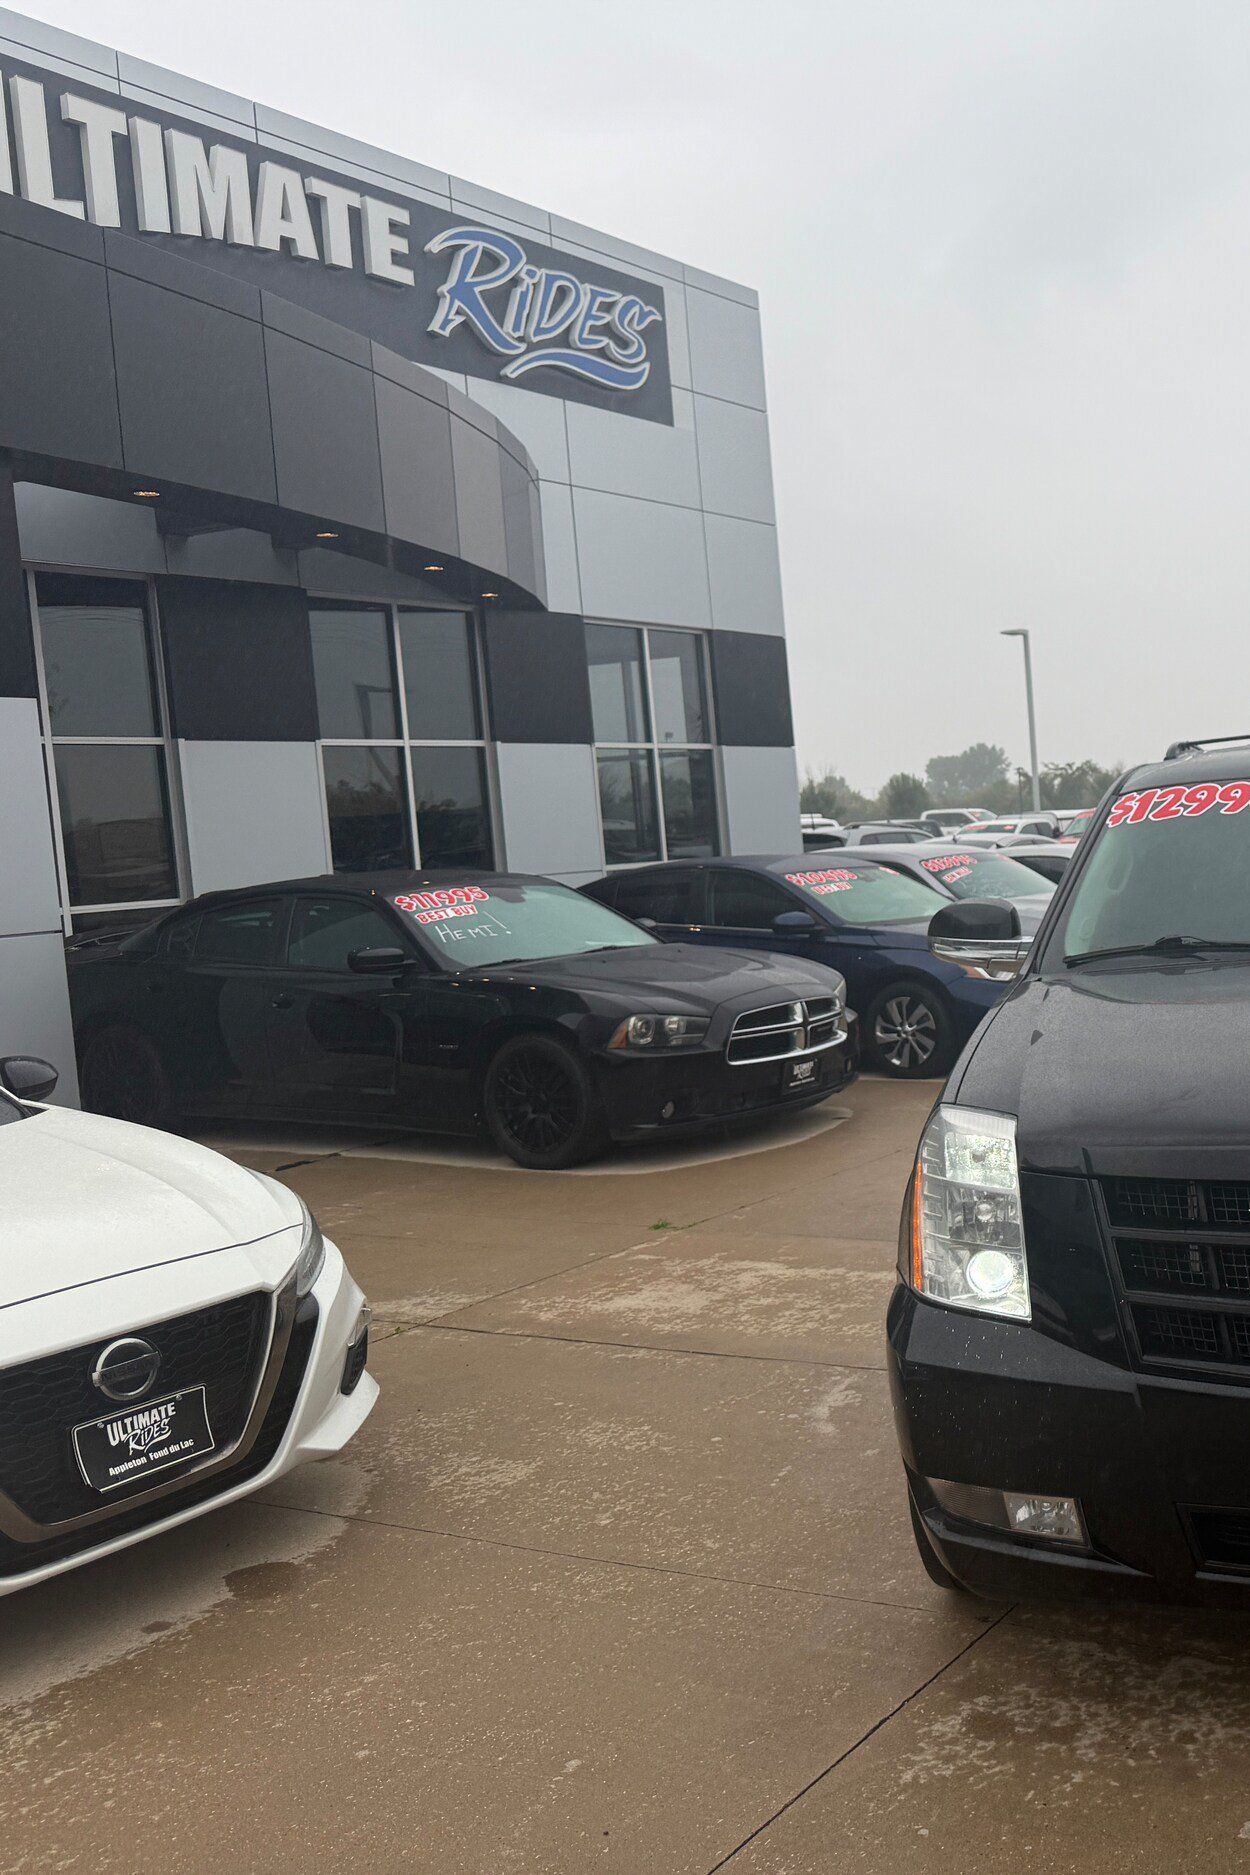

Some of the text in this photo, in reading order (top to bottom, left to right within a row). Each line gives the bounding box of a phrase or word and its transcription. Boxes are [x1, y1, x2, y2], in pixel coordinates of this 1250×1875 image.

[0, 69, 415, 287] LTIMATE
[395, 886, 490, 911] $11995
[415, 904, 478, 924] BEST BUY
[107, 1402, 176, 1447] ULTIMATE
[109, 1438, 194, 1476] Appleton Fond du Lac
